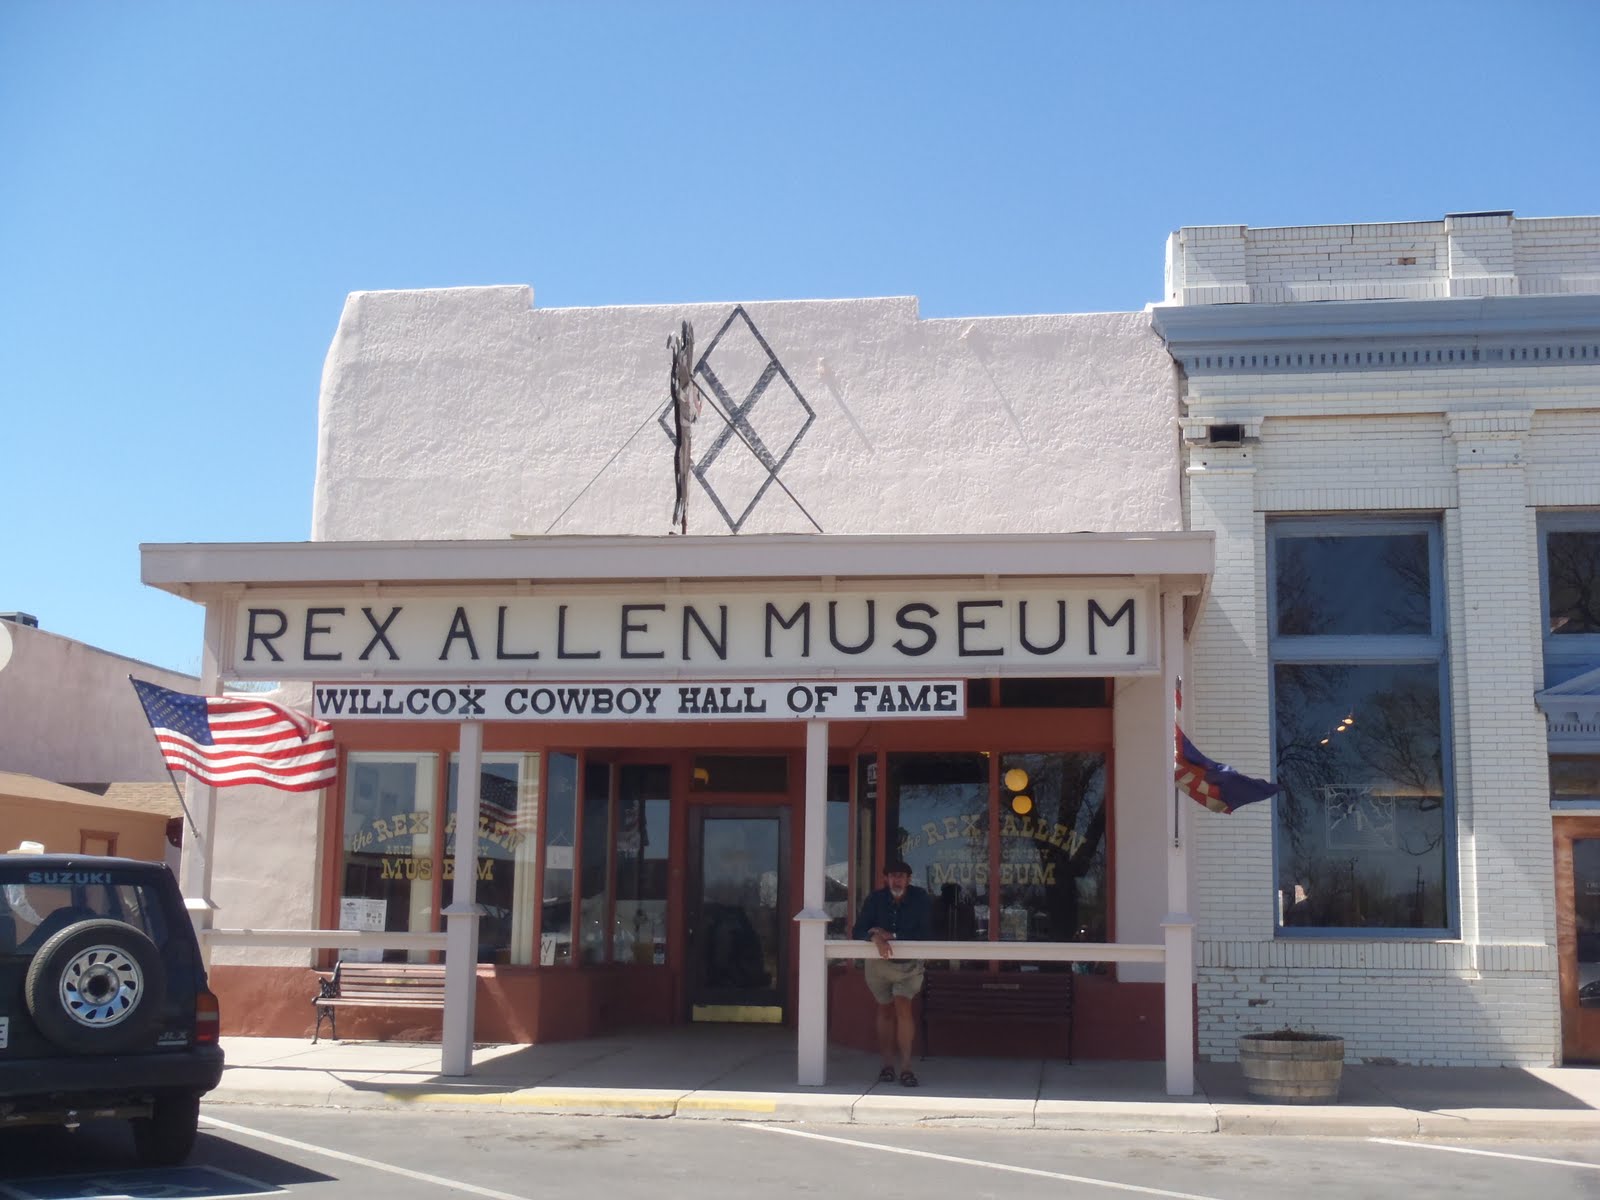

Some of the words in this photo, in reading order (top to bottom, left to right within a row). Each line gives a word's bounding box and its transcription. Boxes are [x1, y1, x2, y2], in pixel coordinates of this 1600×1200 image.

[243, 606, 403, 662] REX
[438, 603, 728, 661] ALLEN
[764, 599, 1136, 660] MUSEUM
[316, 687, 486, 716] WILLCOX
[504, 686, 662, 715] COWBOY
[678, 686, 767, 714] HALL
[786, 685, 838, 713] OF
[854, 683, 958, 713] FAME
[352, 830, 373, 853] the
[372, 811, 430, 842] REX
[921, 814, 981, 846] REX
[1000, 814, 1088, 858] ALLEN
[28, 871, 112, 885] SUZUKI
[380, 858, 495, 881] MUSEM
[932, 862, 1056, 885] MUSEUM
